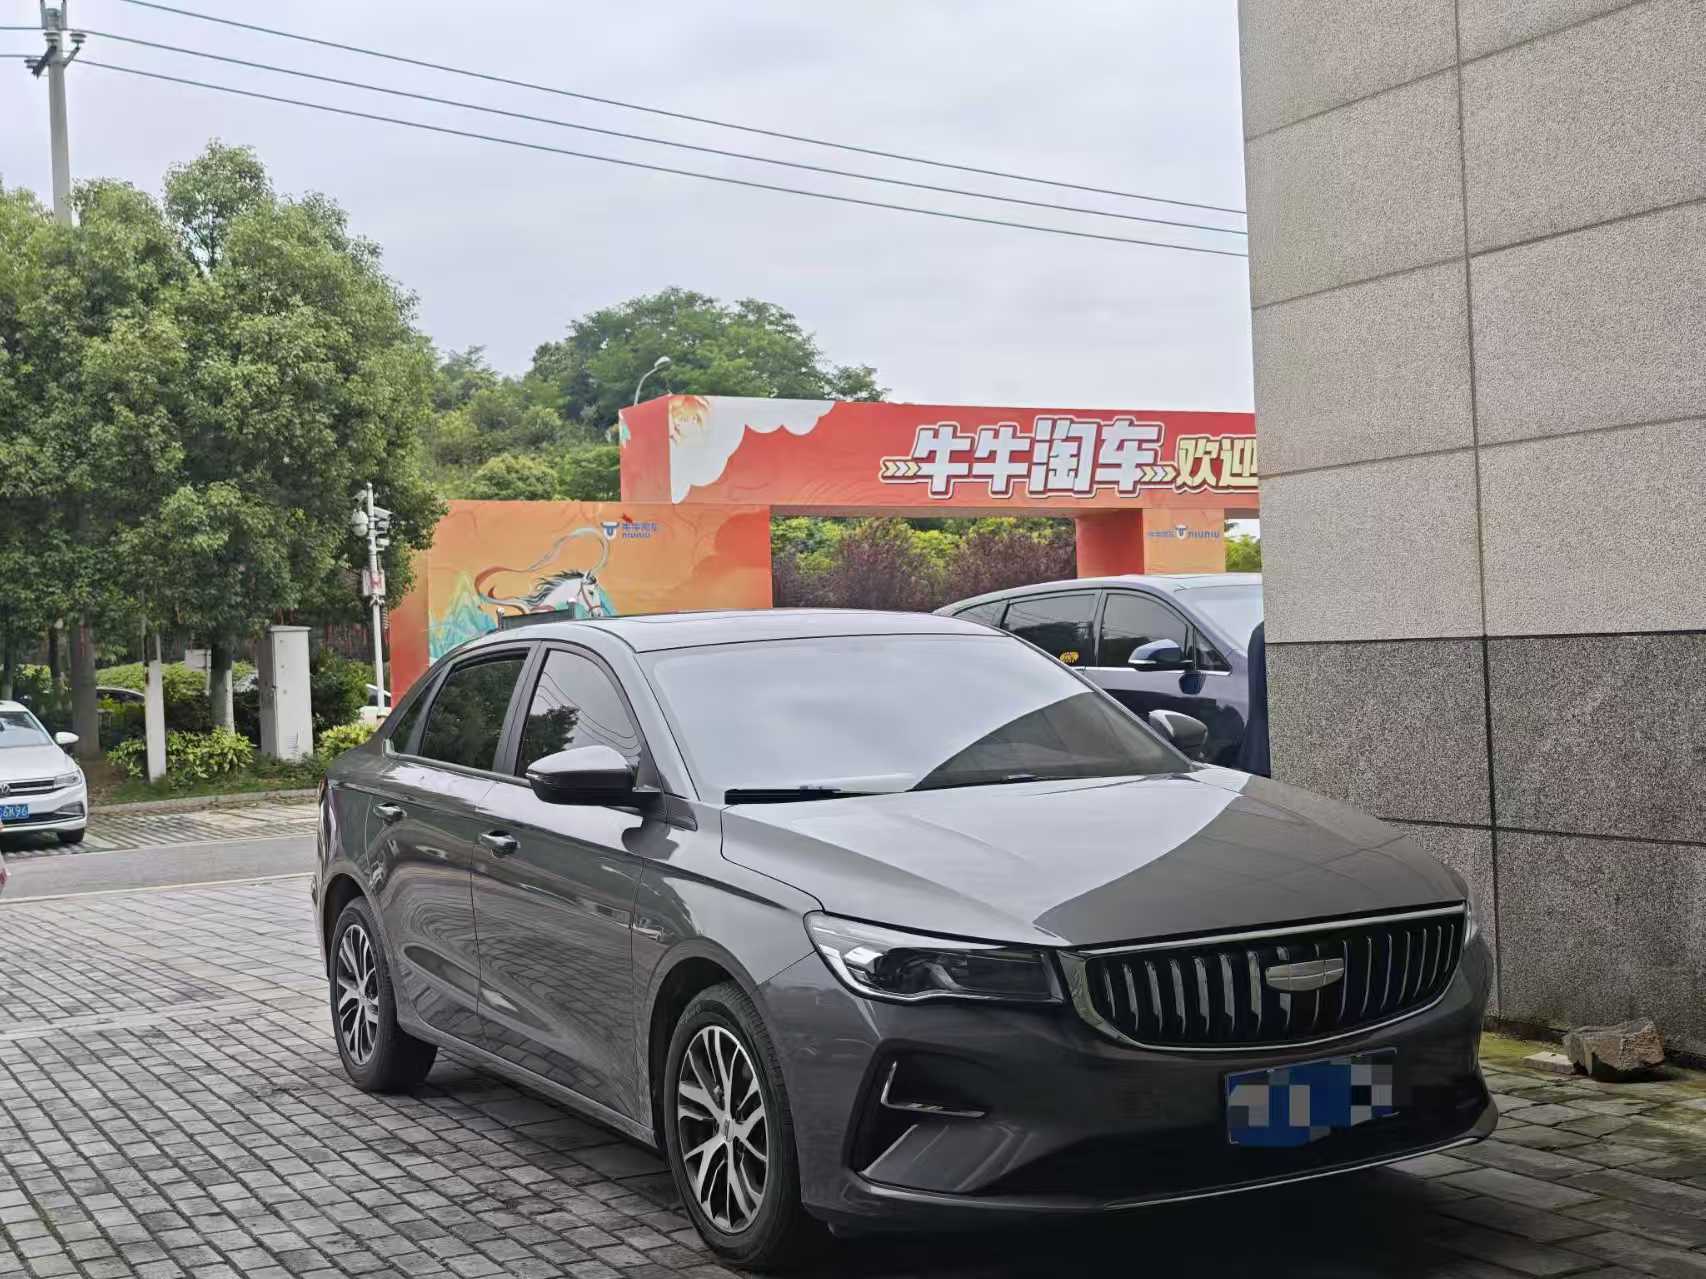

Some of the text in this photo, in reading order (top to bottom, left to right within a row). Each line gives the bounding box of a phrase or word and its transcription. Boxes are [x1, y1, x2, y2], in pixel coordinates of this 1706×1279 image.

[911, 417, 1258, 495] 牛牛淘车 欢迎
